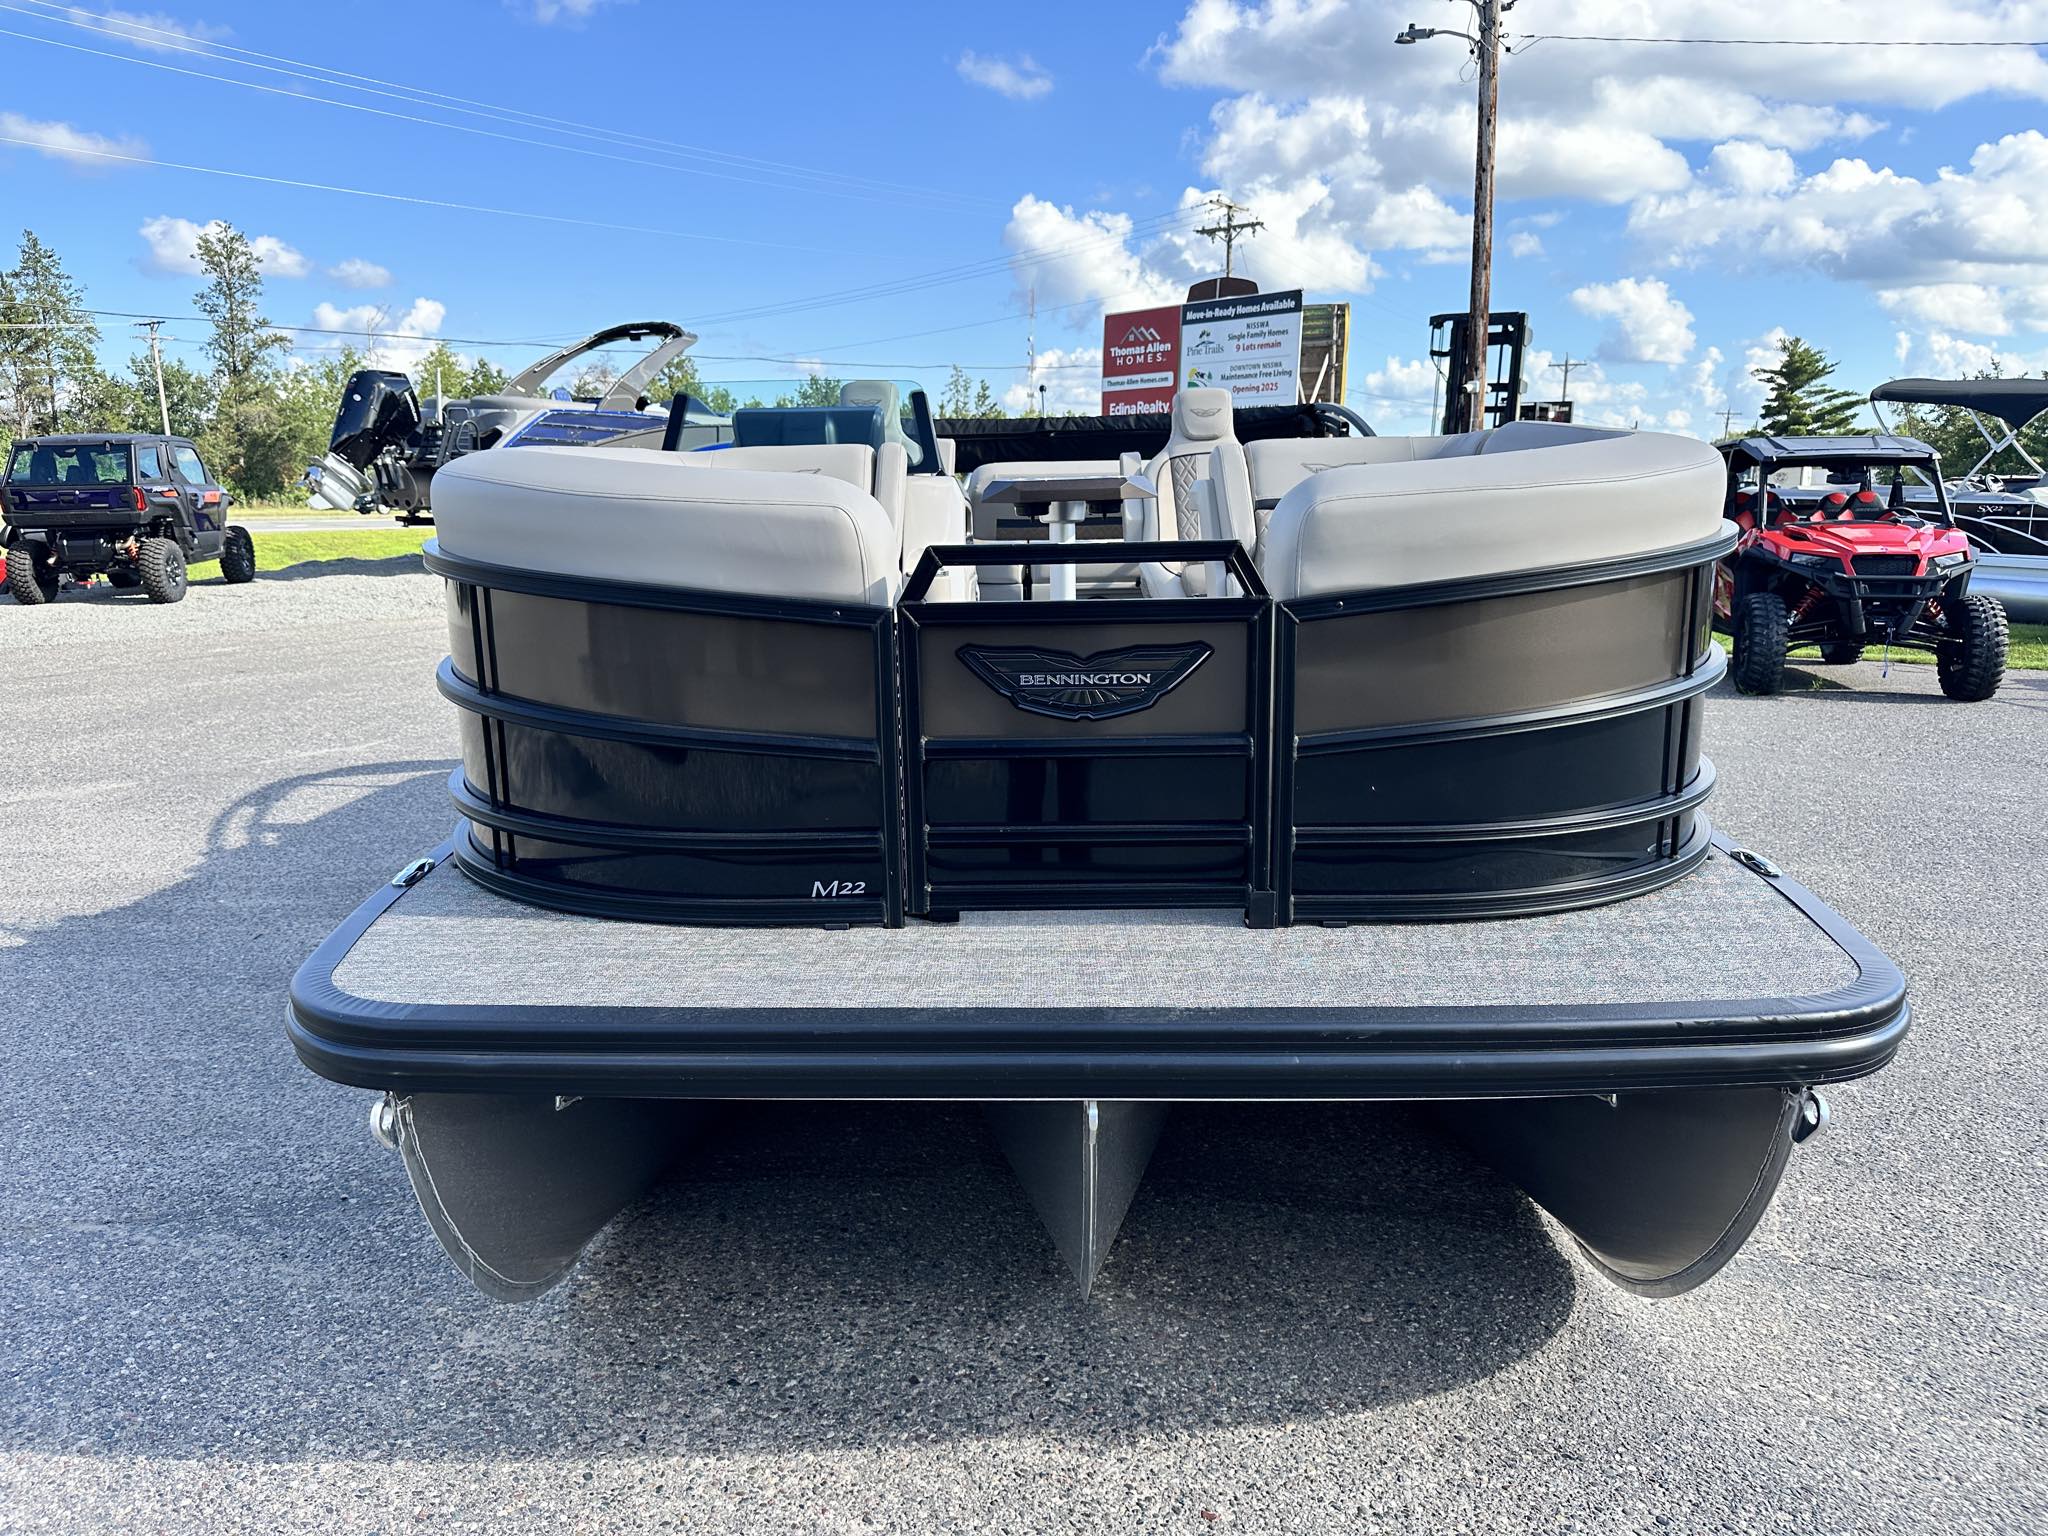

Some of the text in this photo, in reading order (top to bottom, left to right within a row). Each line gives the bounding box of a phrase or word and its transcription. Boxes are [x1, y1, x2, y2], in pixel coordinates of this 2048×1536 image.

[1186, 299, 1295, 320] Move-in-Ready Homes Available
[1246, 320, 1269, 330] NISSWA
[1227, 328, 1289, 342] Single Family Homes
[1110, 341, 1172, 357] Thomas Allen
[1186, 344, 1225, 357] Pine Trails
[1235, 340, 1281, 352] 9 Lots remain
[1230, 361, 1282, 372] DOWNTOWN NISSWA
[1220, 369, 1292, 381] Maintenance Free Living
[1232, 382, 1279, 395] Opening 2025
[1976, 504, 2004, 513] SX22
[1020, 673, 1151, 686] BENNINGTON
[811, 880, 866, 898] M22
